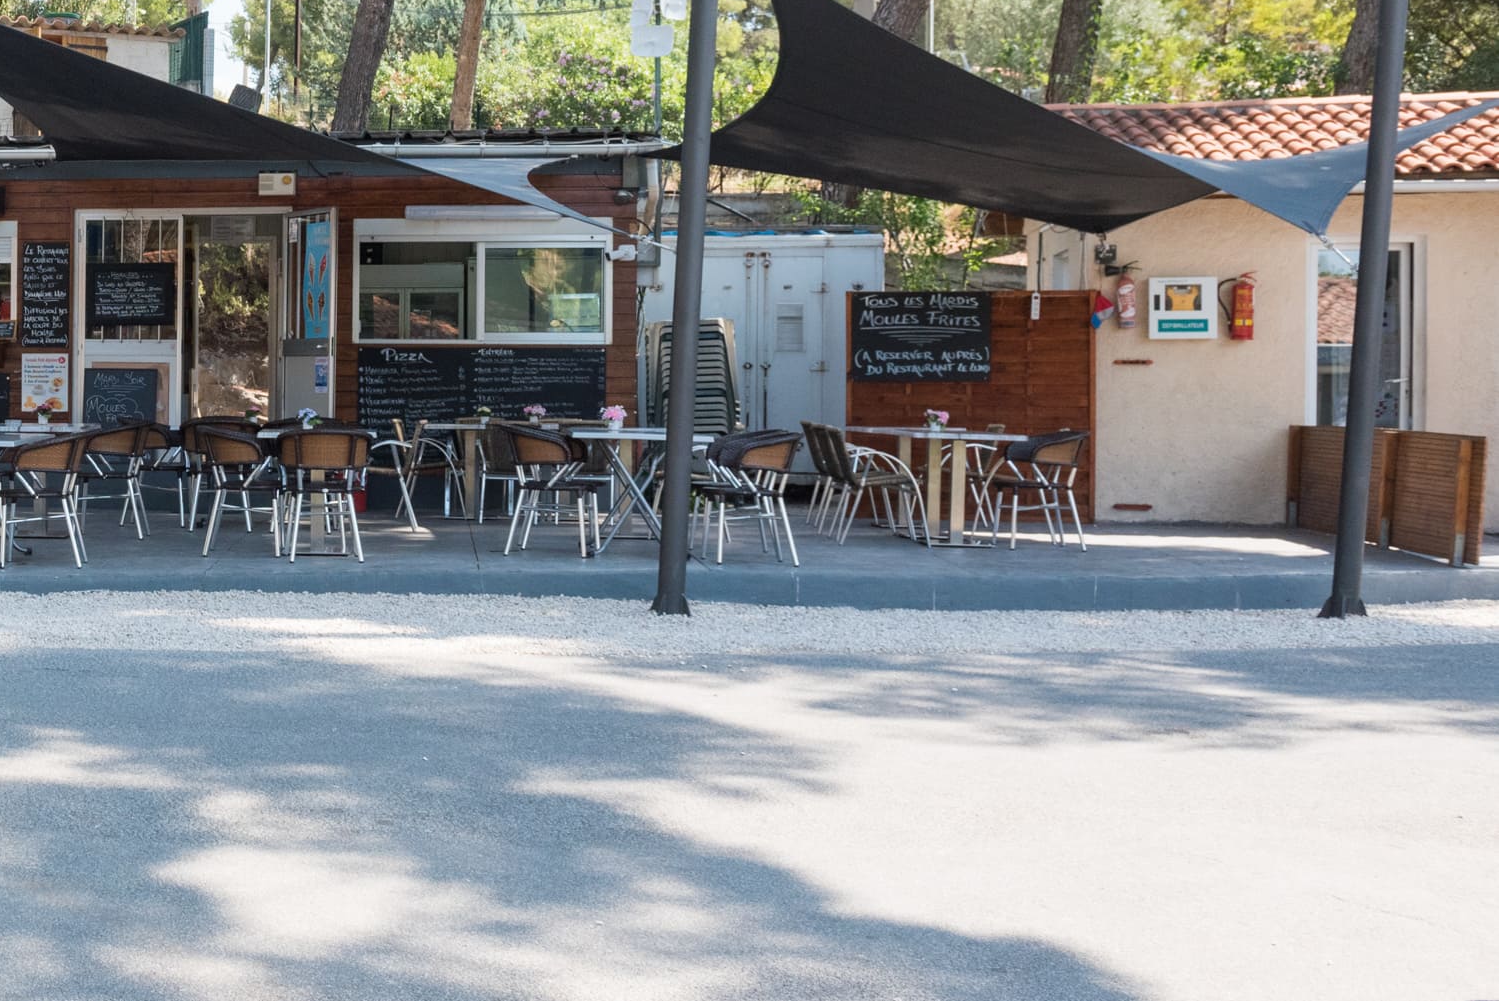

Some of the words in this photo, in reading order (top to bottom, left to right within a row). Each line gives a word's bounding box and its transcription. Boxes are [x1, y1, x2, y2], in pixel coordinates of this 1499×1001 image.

[860, 294, 899, 307] TOUS
[904, 296, 924, 306] LES
[929, 293, 979, 309] MARDIS
[859, 310, 919, 327] MOULES
[926, 311, 981, 327] FRITES
[380, 347, 434, 364] PIZZA
[865, 364, 883, 376] DU
[886, 362, 956, 377] RESTAURANT
[87, 397, 127, 416] MOULES
